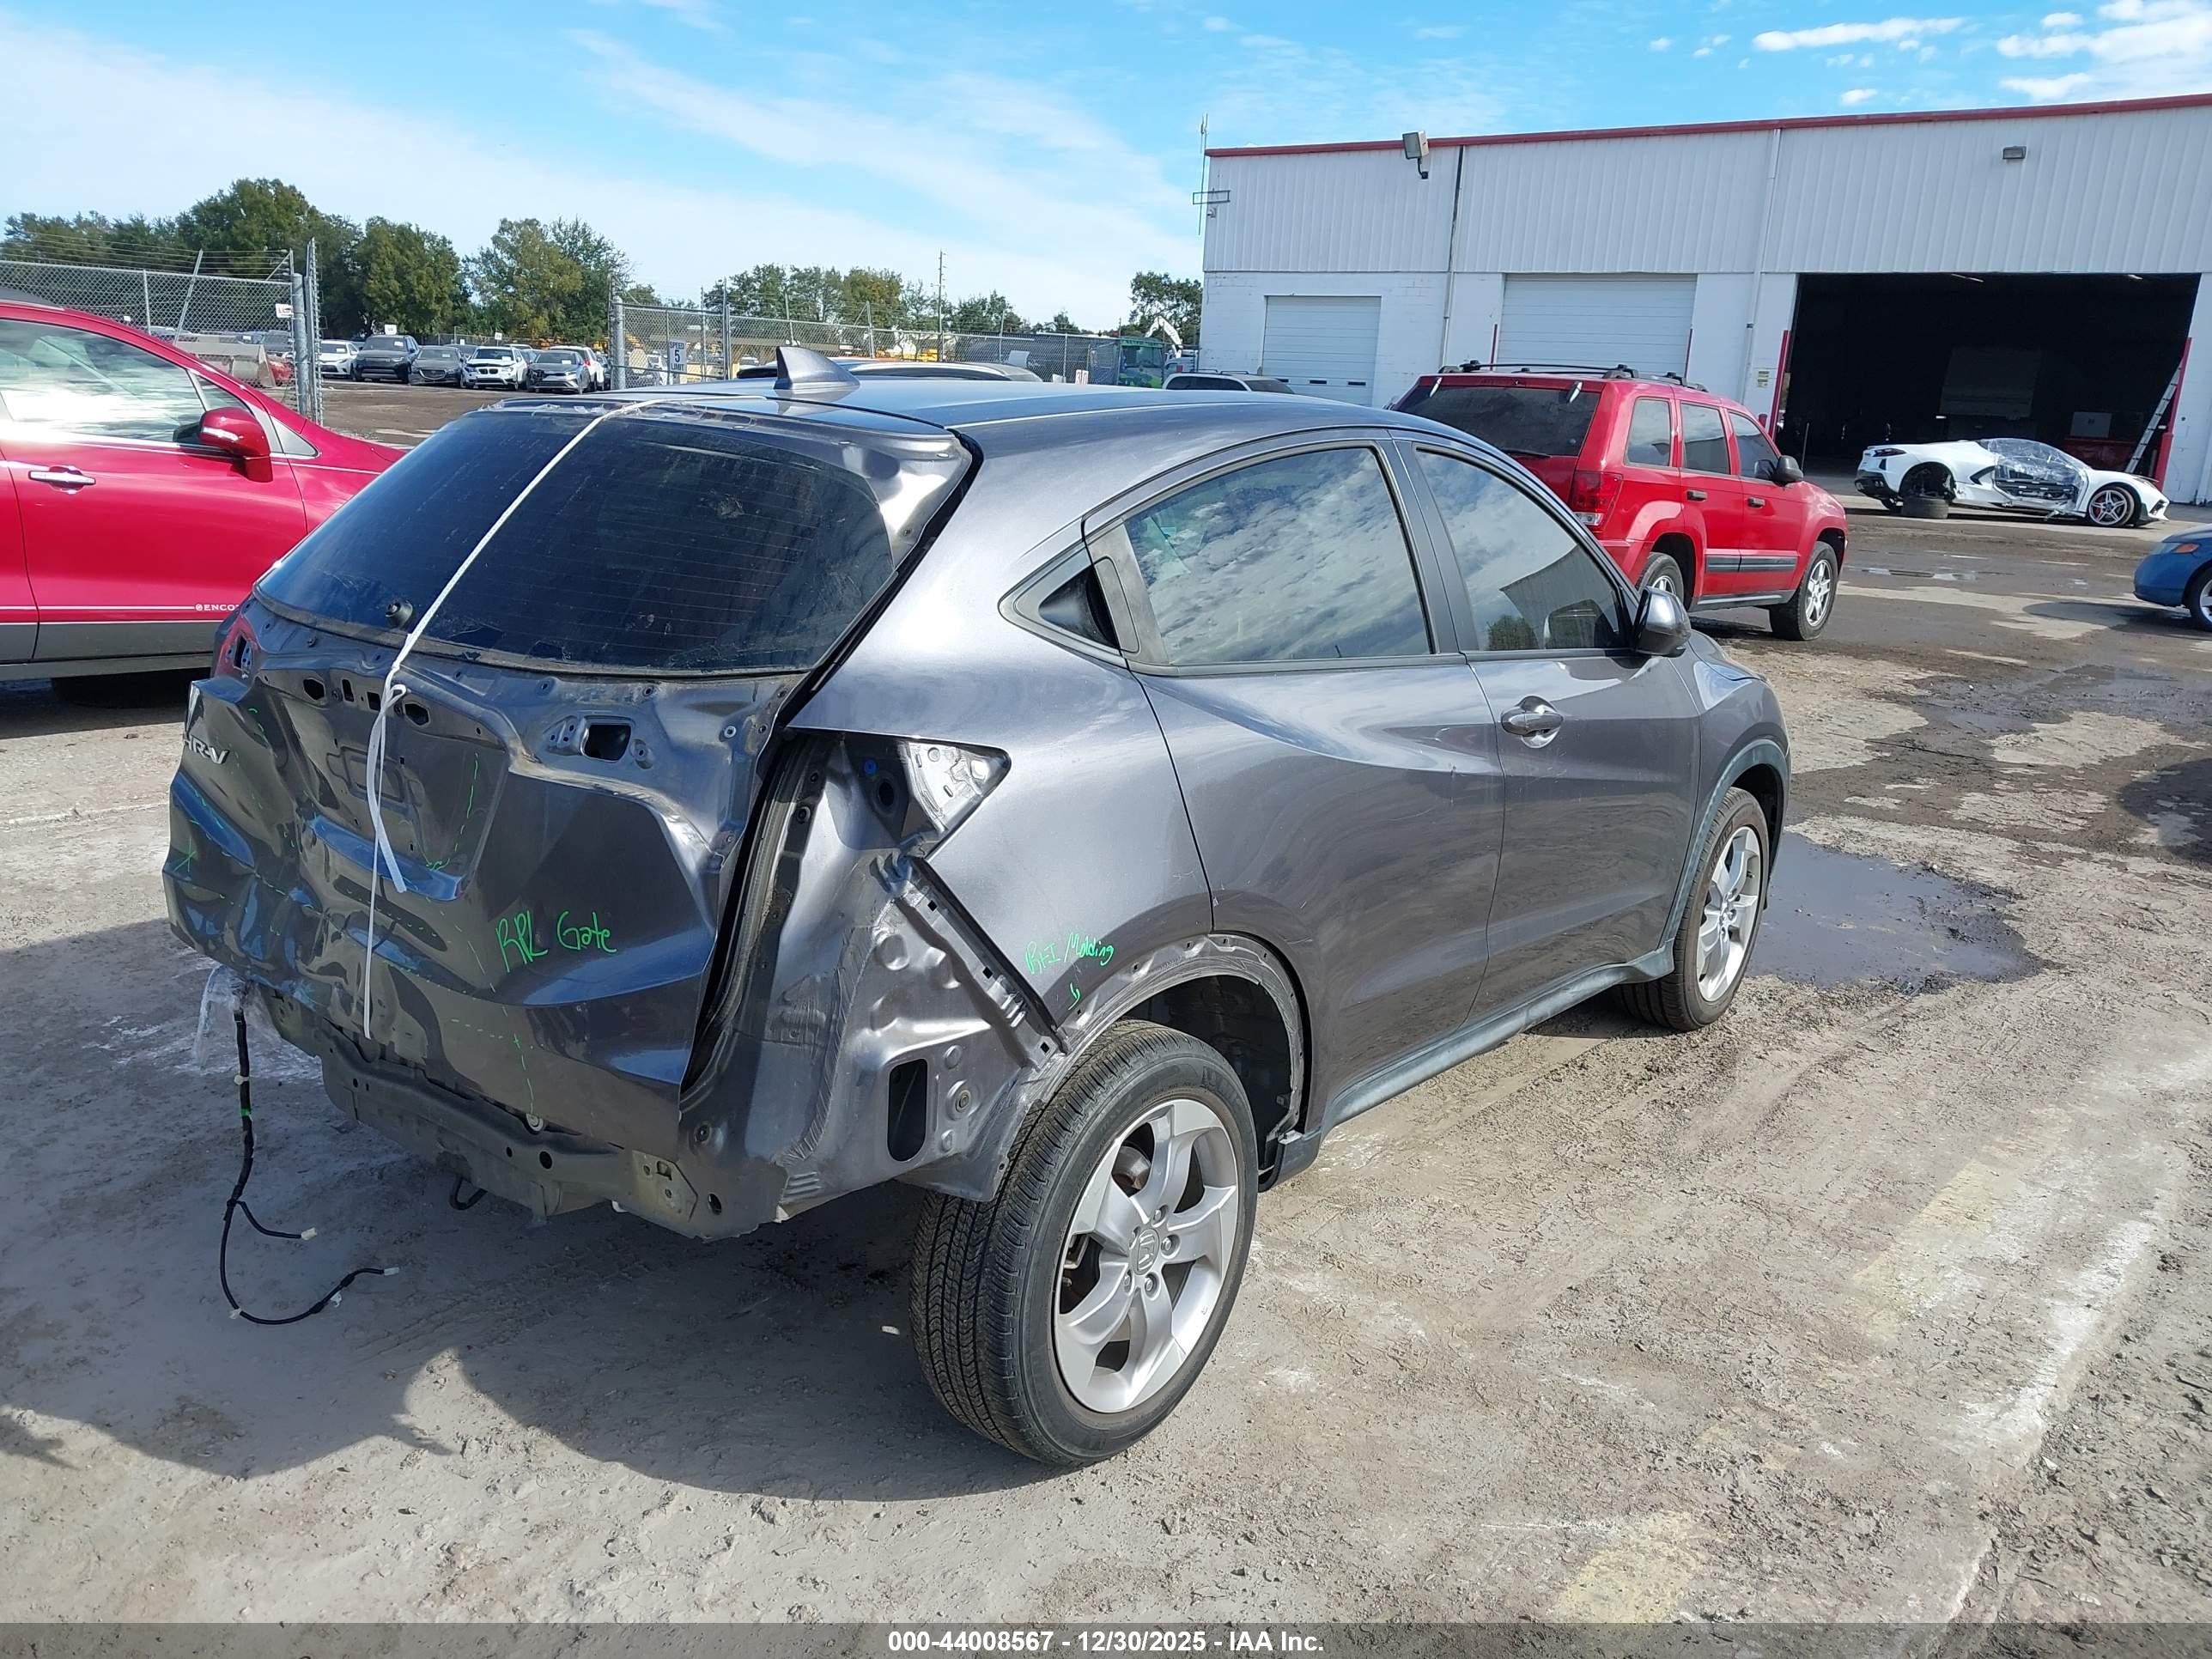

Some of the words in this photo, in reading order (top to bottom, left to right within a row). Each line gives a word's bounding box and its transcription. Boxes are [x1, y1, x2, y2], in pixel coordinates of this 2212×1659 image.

[671, 363, 685, 372] LIMIT
[674, 349, 681, 363] 5
[556, 910, 618, 953] Gate
[1063, 933, 1115, 967] Molding
